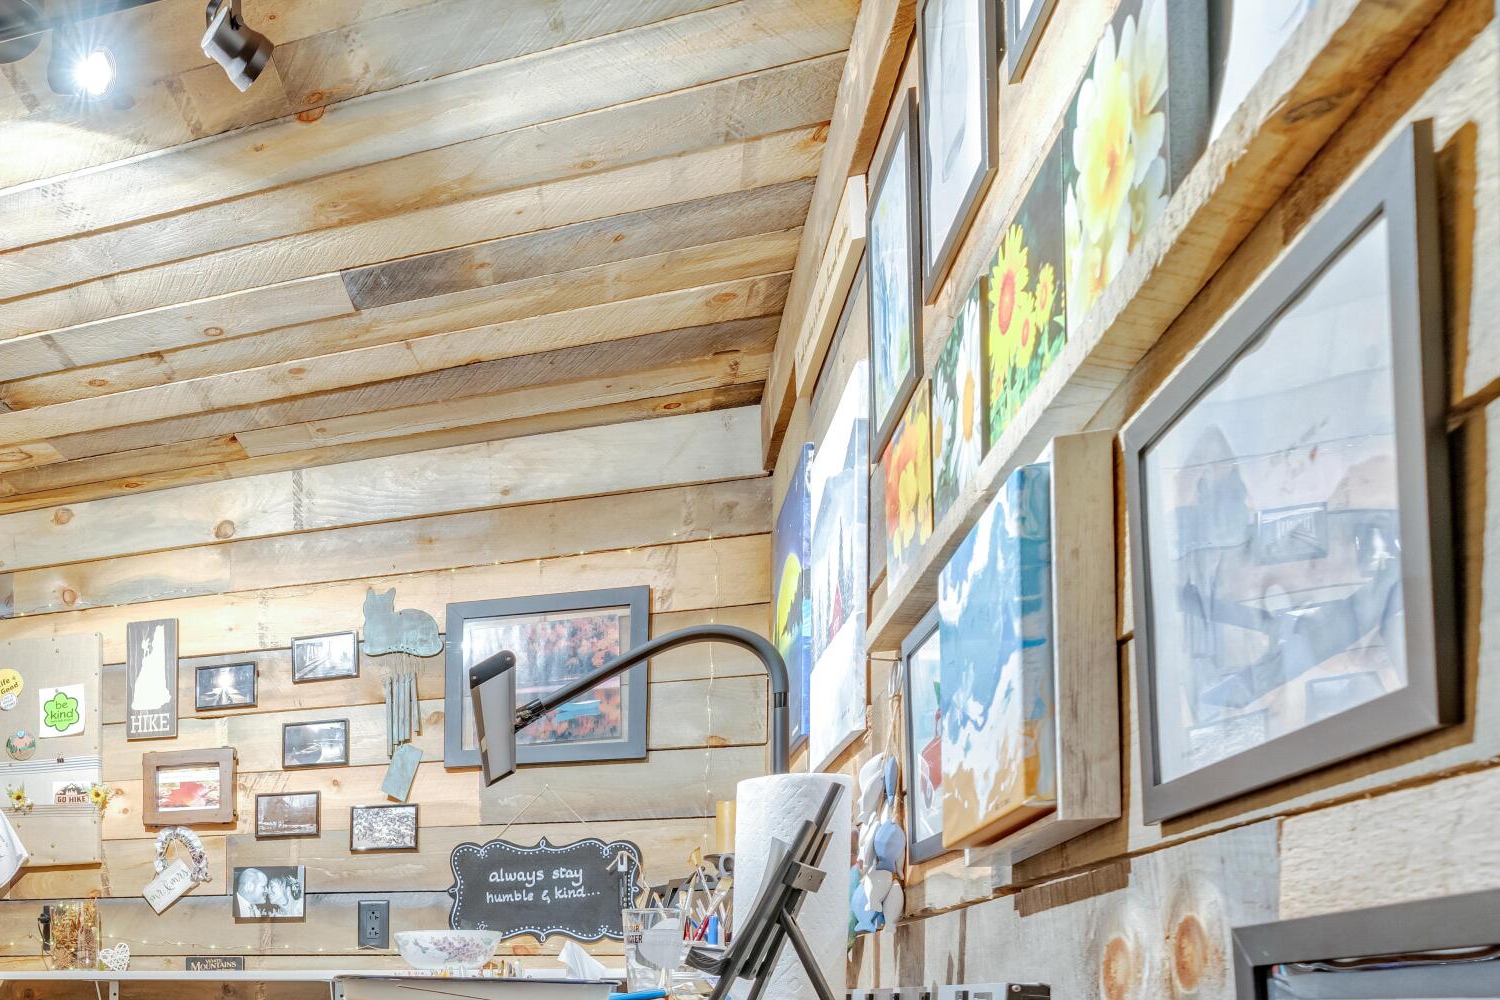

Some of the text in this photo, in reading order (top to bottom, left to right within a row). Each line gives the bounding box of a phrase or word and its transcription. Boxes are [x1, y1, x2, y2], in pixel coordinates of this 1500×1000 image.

[0, 682, 19, 695] Good
[55, 700, 69, 710] be
[50, 707, 74, 720] kind
[130, 713, 170, 734] HIKE
[68, 795, 86, 803] HIKE
[488, 866, 583, 888] always stay
[486, 890, 534, 904] humble
[541, 891, 551, 904] &
[191, 961, 237, 971] MOUNTAINS
